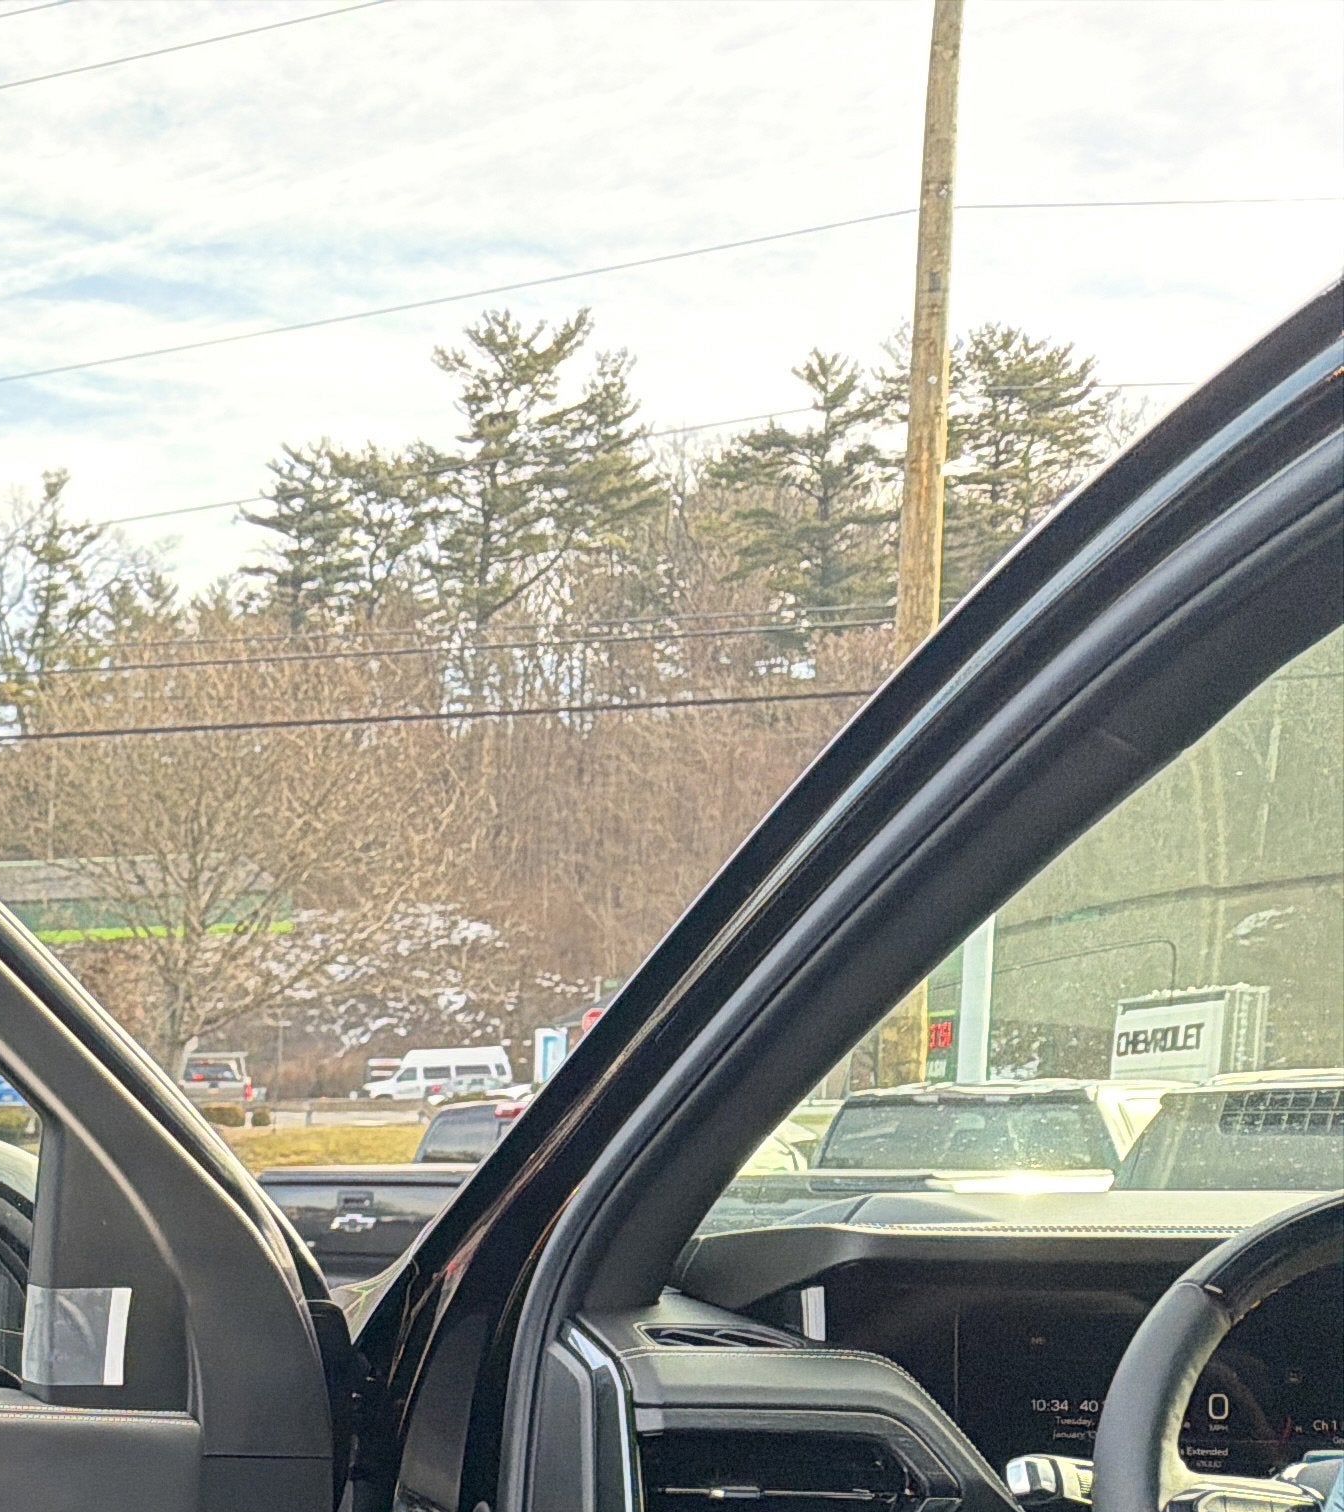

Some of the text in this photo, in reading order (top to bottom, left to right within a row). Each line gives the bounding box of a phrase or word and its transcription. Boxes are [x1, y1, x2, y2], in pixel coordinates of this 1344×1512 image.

[1116, 1022, 1205, 1057] CHEVROLET
[1031, 1399, 1069, 1412] 10:34
[1208, 1393, 1229, 1420] 0
[1313, 1420, 1329, 1431] Ch
